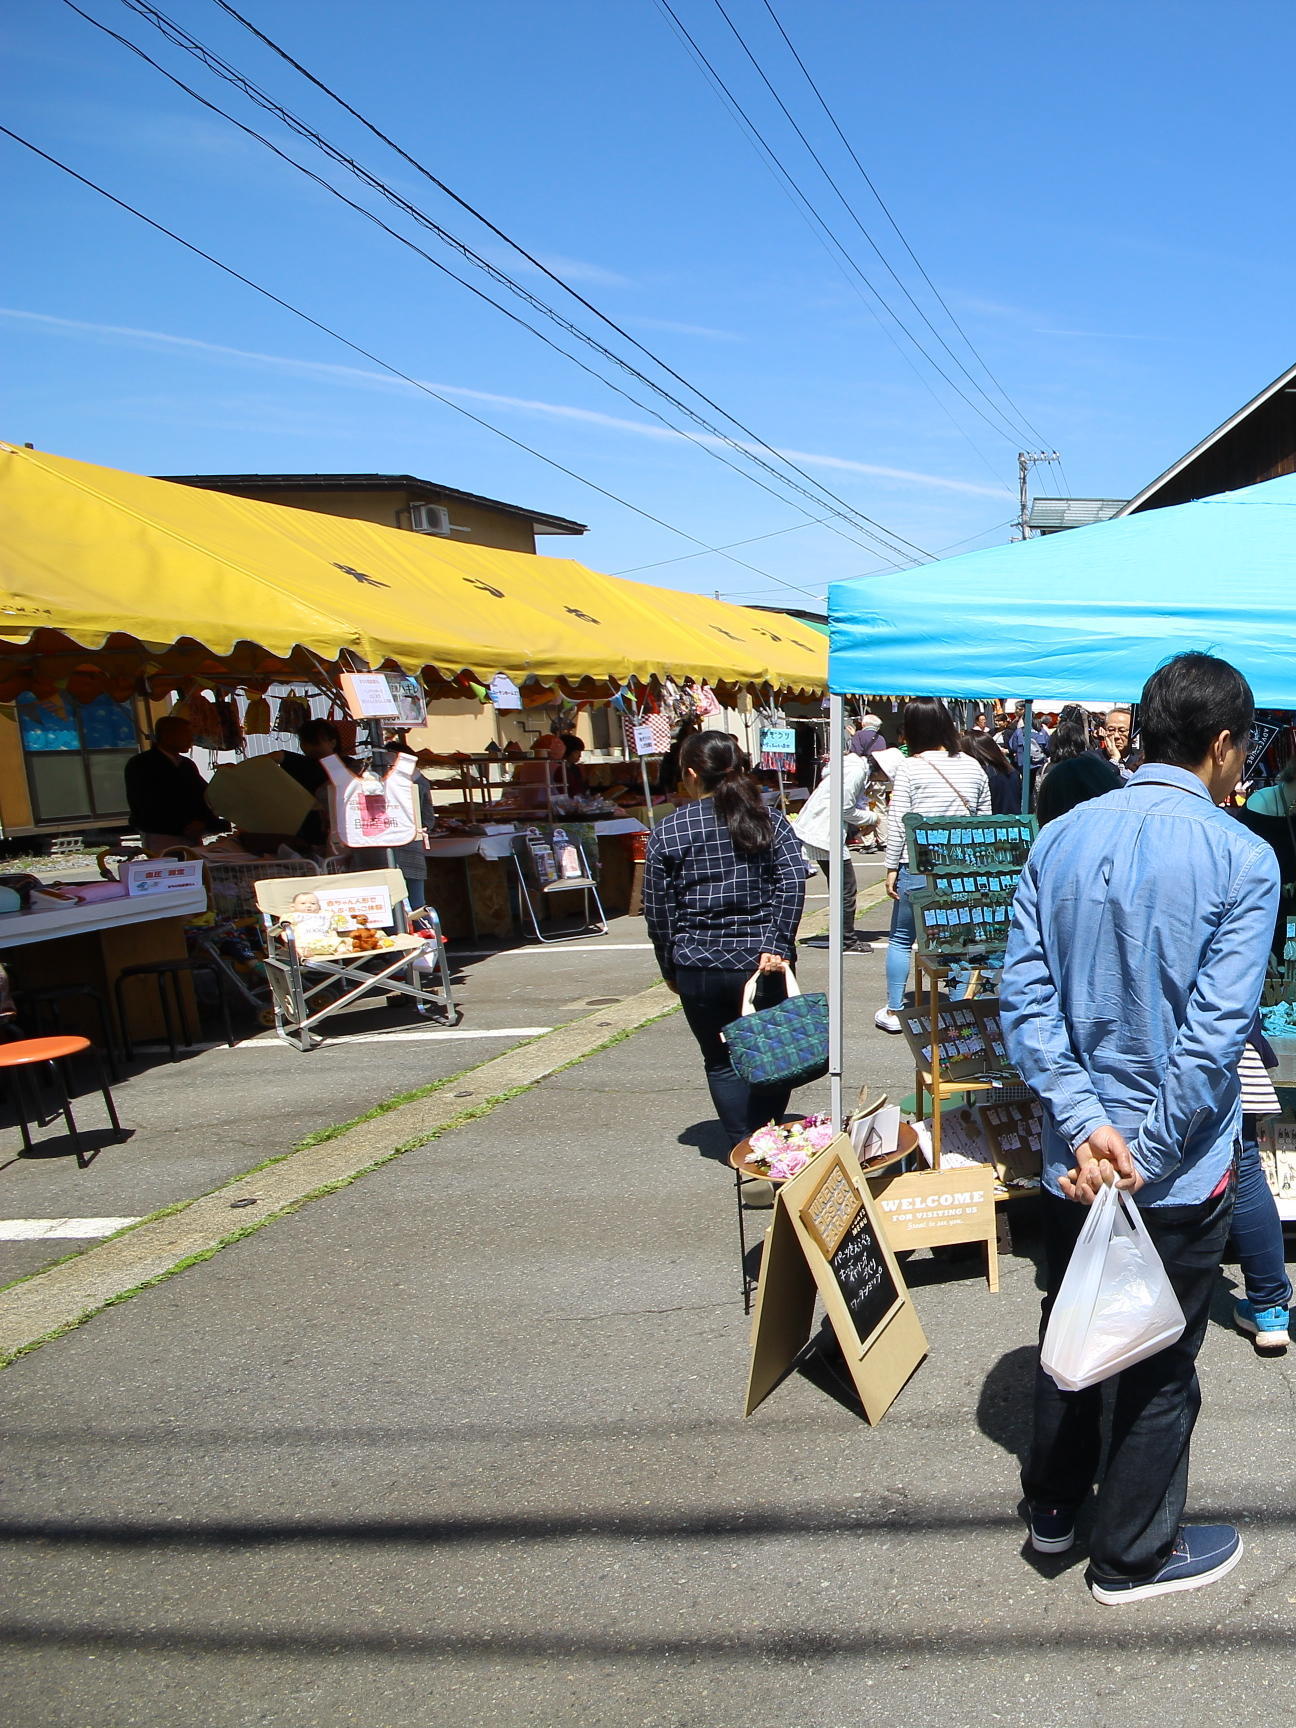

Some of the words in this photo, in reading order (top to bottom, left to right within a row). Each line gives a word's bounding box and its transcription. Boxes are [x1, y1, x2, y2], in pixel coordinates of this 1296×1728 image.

[881, 1191, 984, 1212] WELCOME
[892, 1213, 912, 1222] FOR
[916, 1208, 963, 1219] VISITING
[966, 1206, 978, 1215] US
[852, 1217, 867, 1236] MENU
